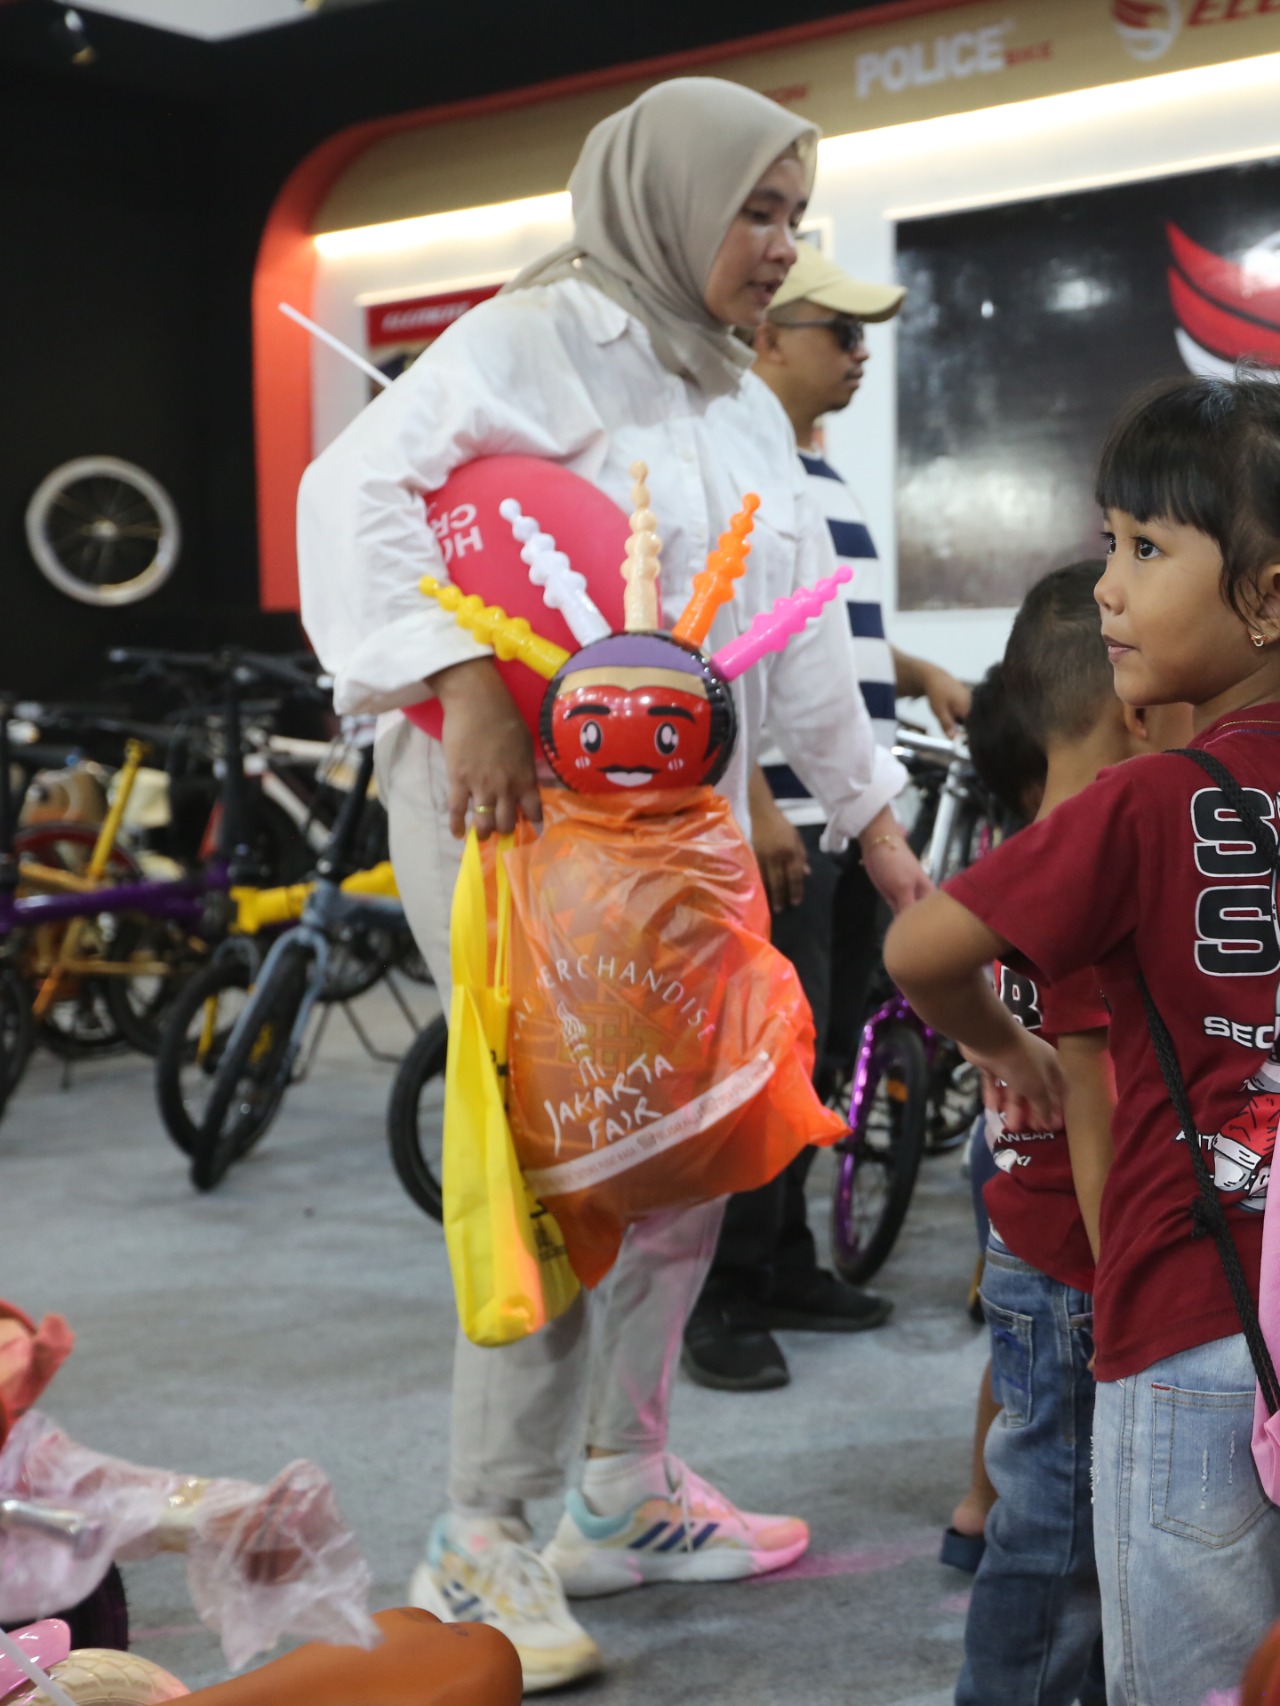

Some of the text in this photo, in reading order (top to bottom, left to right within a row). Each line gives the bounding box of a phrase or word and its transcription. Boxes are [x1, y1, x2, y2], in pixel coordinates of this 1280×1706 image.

[856, 25, 1005, 98] POLICE
[544, 1053, 674, 1157] JAKARTA
[588, 1096, 662, 1150] FAIR
